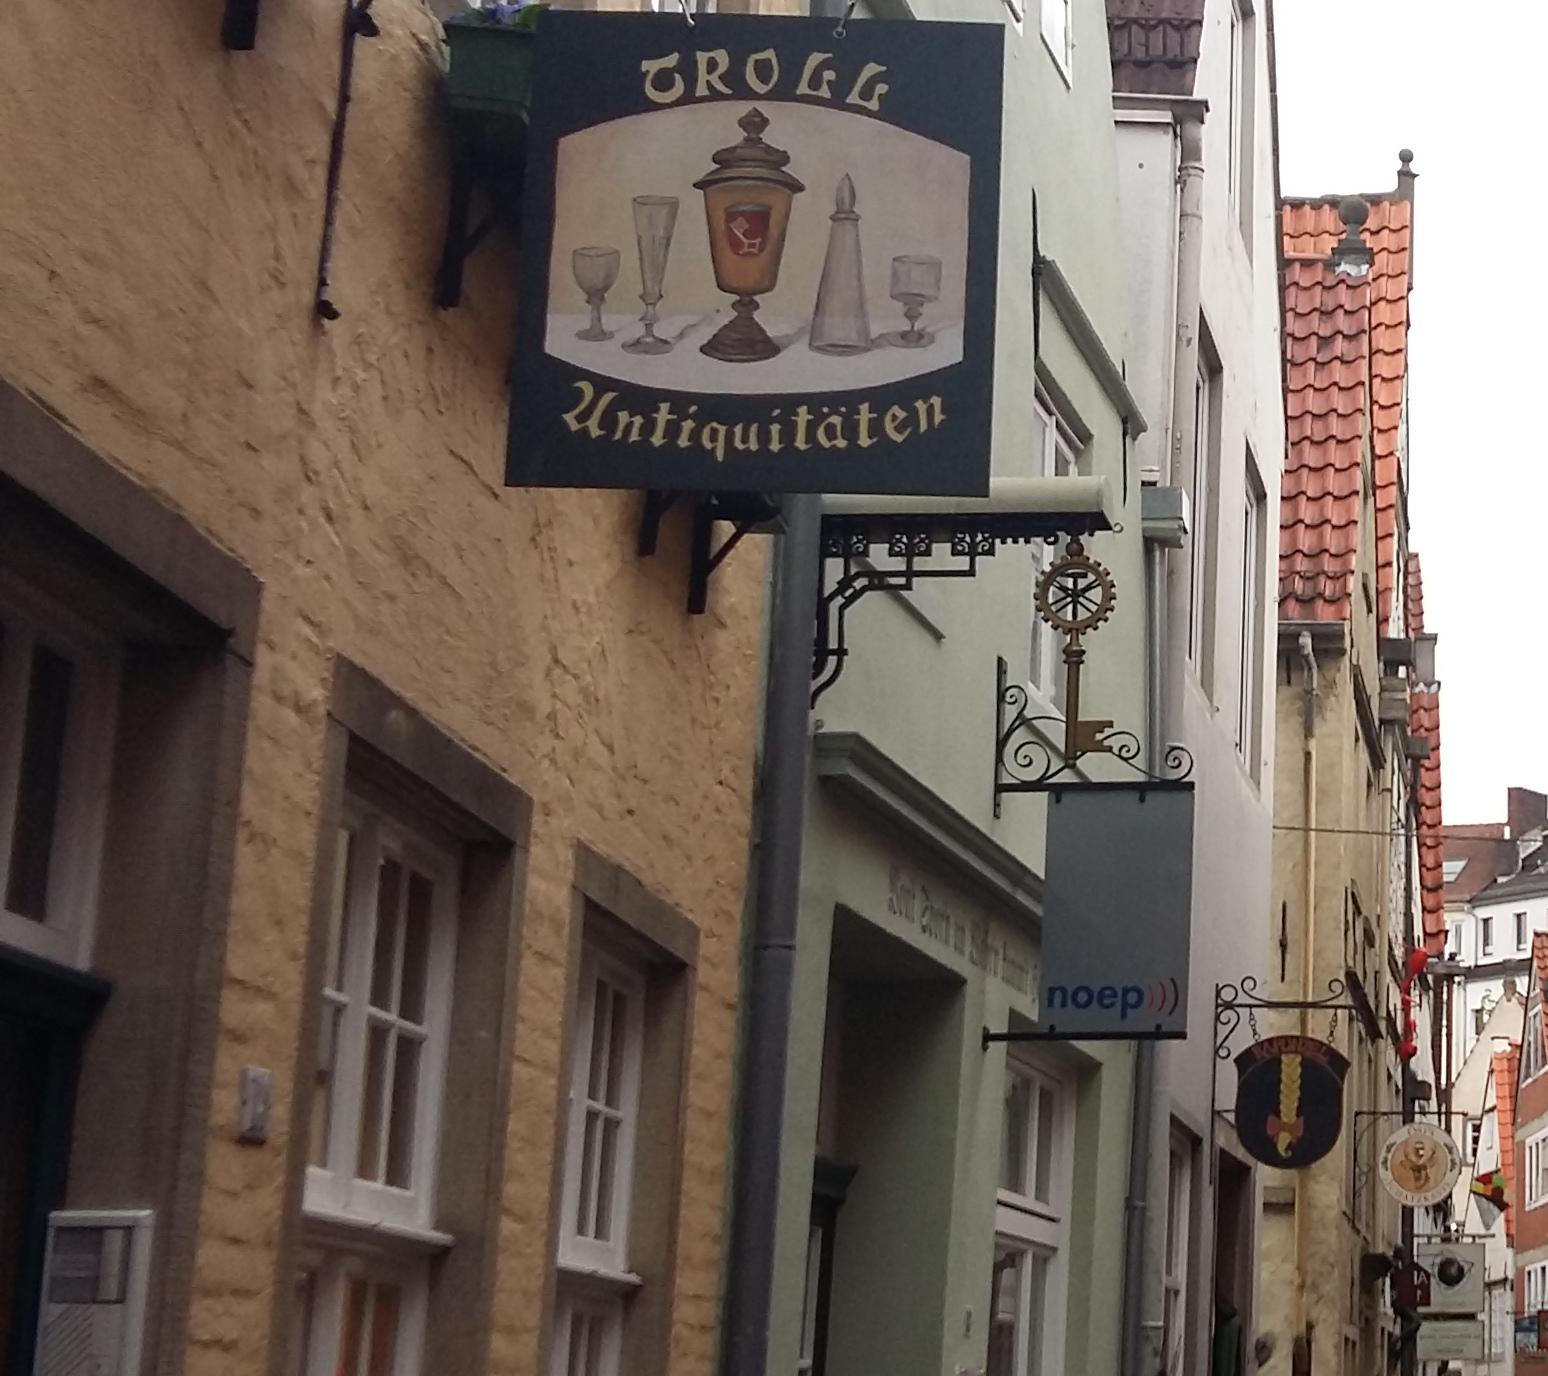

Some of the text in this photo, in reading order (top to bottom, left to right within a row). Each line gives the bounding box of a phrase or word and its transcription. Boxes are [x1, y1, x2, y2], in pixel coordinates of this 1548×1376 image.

[641, 47, 890, 111] TROLL
[561, 380, 948, 462] Antiquitäten
[1047, 985, 1144, 1020] noep
